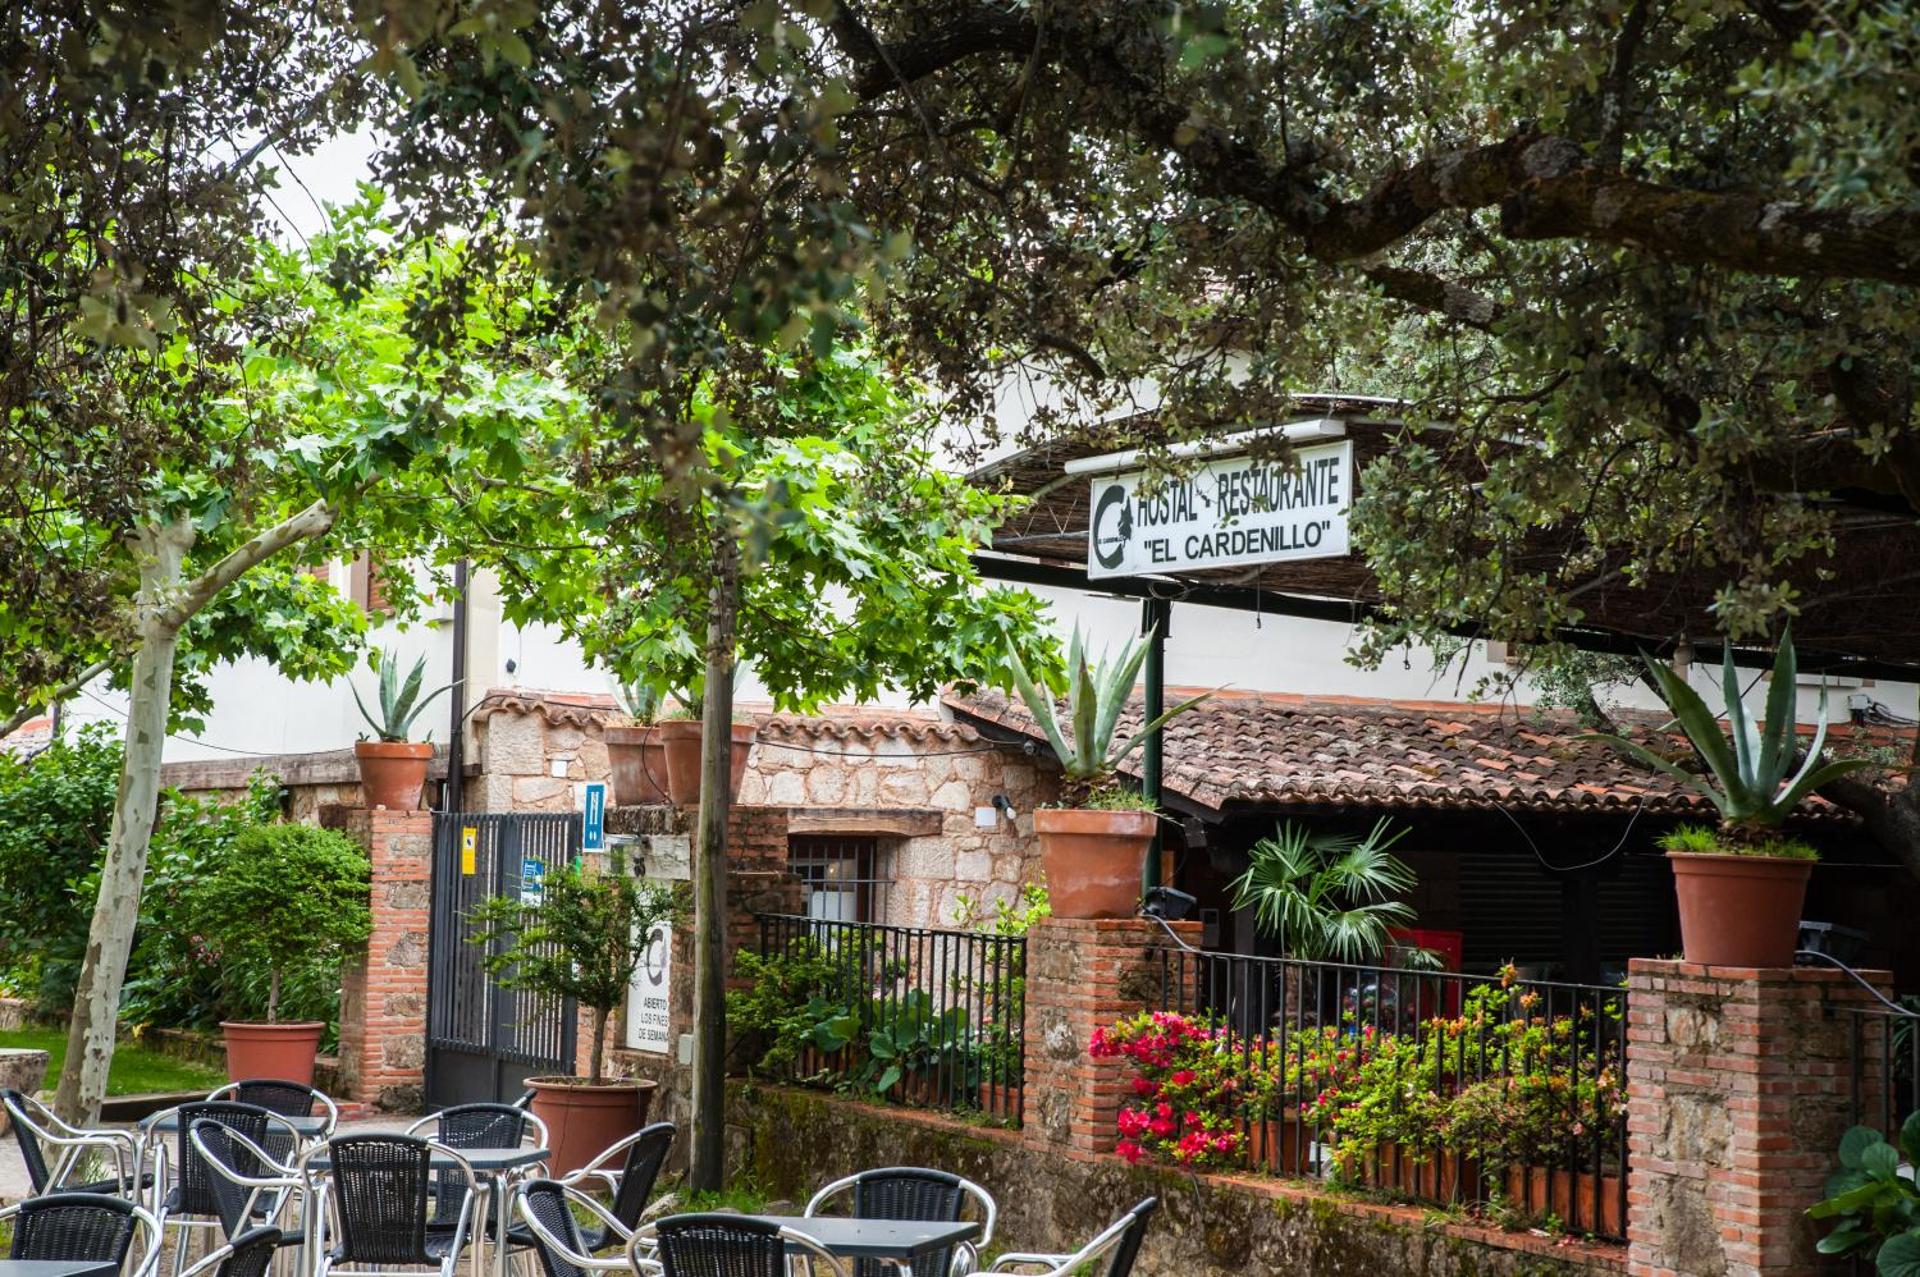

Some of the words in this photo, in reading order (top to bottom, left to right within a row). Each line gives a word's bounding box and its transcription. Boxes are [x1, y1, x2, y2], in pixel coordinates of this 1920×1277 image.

[1138, 479, 1197, 528] HOSTAL
[1218, 457, 1339, 517] RESTAURANTE
[1144, 538, 1177, 564] "EL
[1185, 520, 1331, 560] CARDENILLO"
[644, 997, 668, 1010] ABIERTO
[641, 1012, 652, 1024] LOS
[652, 1013, 668, 1027] FINES
[638, 1028, 646, 1039] DE
